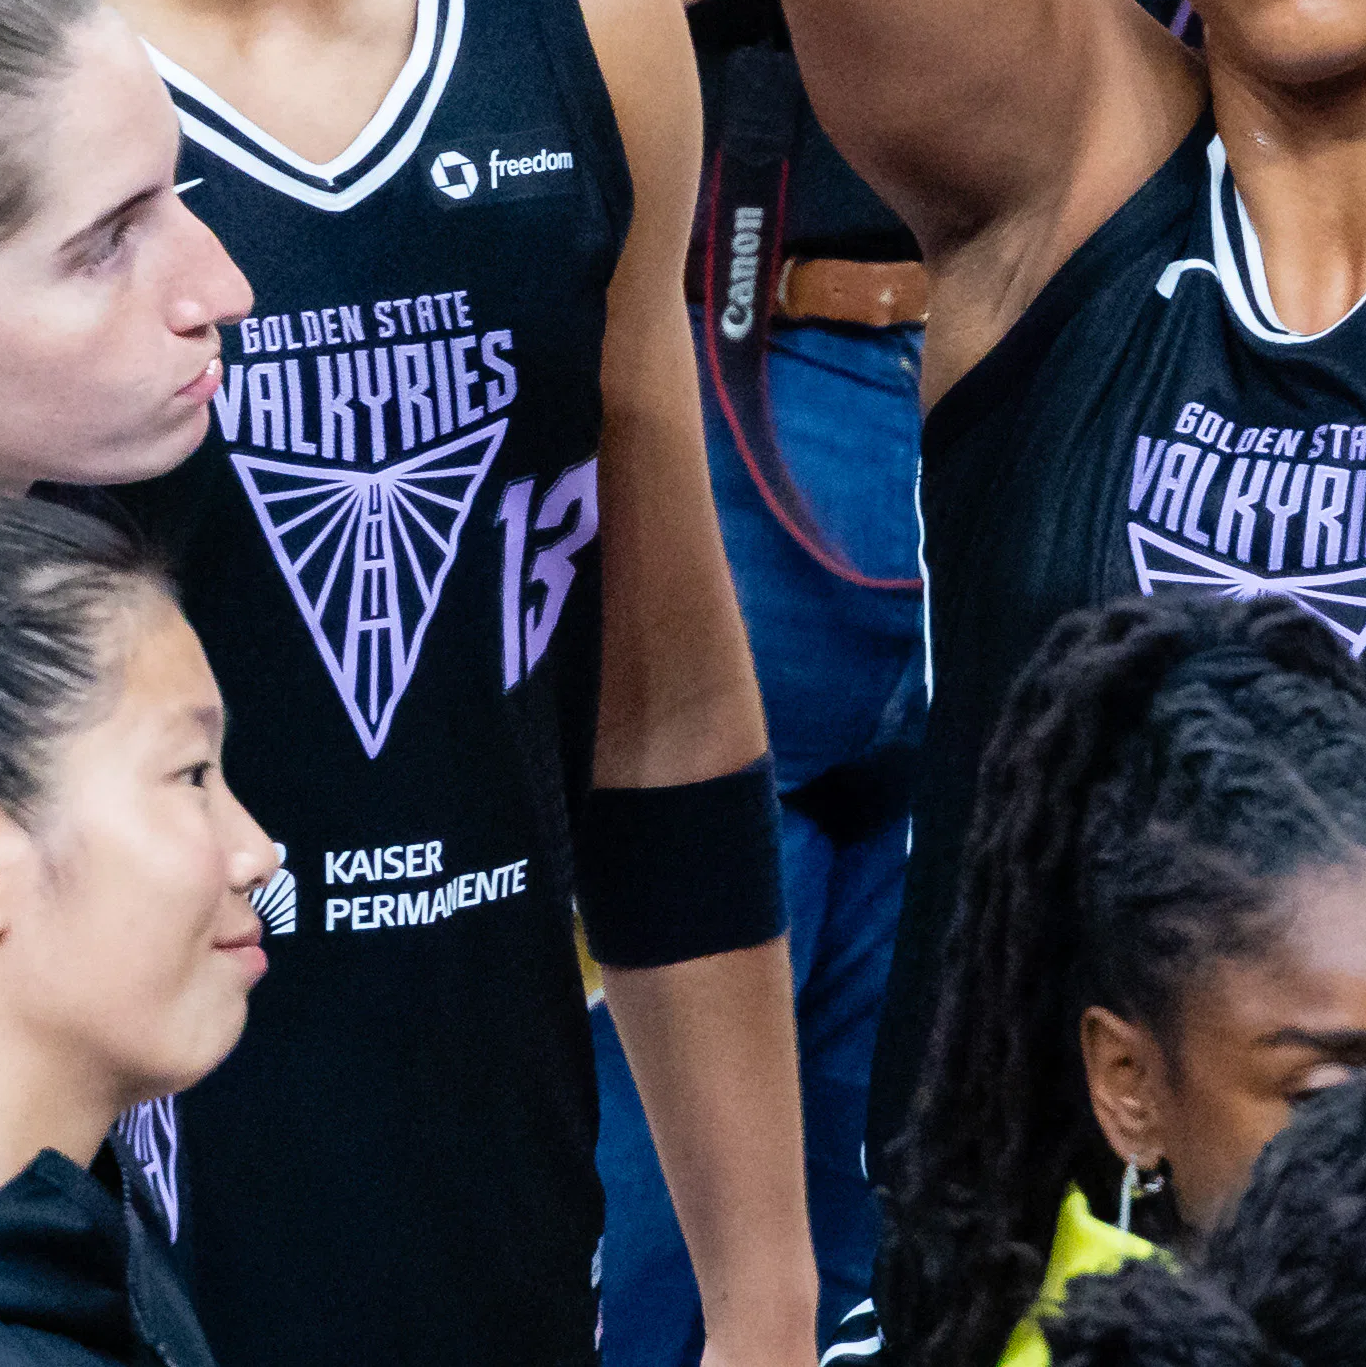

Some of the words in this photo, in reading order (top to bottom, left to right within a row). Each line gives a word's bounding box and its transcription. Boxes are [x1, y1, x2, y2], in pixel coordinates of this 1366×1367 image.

[488, 148, 574, 190] freedom
[721, 207, 764, 342] Canon
[239, 304, 366, 354] GOLDEN
[373, 290, 474, 338] STATE
[212, 329, 519, 464] VALKYRIES
[1174, 401, 1305, 459] GOLDEN
[496, 455, 600, 694] 13
[325, 840, 443, 884] KAISER
[325, 858, 529, 931] PERMANENTE
